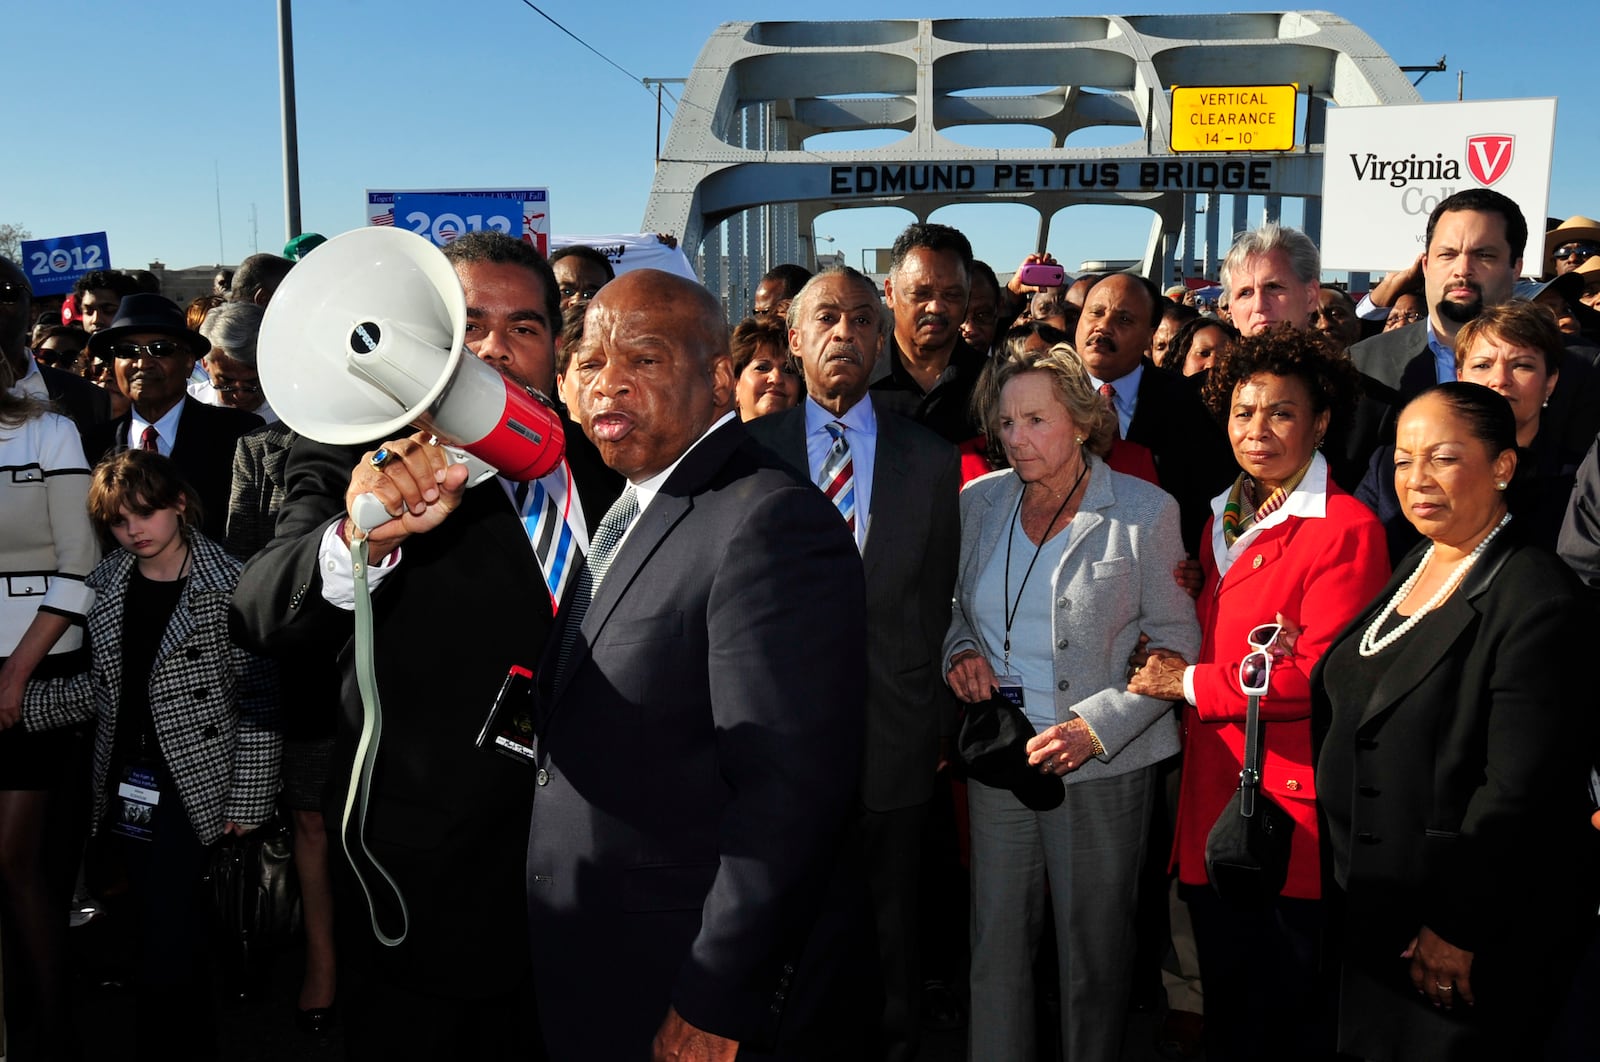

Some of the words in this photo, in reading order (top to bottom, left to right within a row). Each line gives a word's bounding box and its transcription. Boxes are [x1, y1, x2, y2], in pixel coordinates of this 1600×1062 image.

[1200, 92, 1268, 106] VERTICAL
[1190, 112, 1276, 126] CLEARANCE
[830, 165, 976, 194] EDMUND
[994, 164, 1119, 188] PETTUS
[1139, 161, 1272, 190] BRIDGE
[1350, 153, 1461, 188] Virginia
[30, 244, 104, 276] 2012
